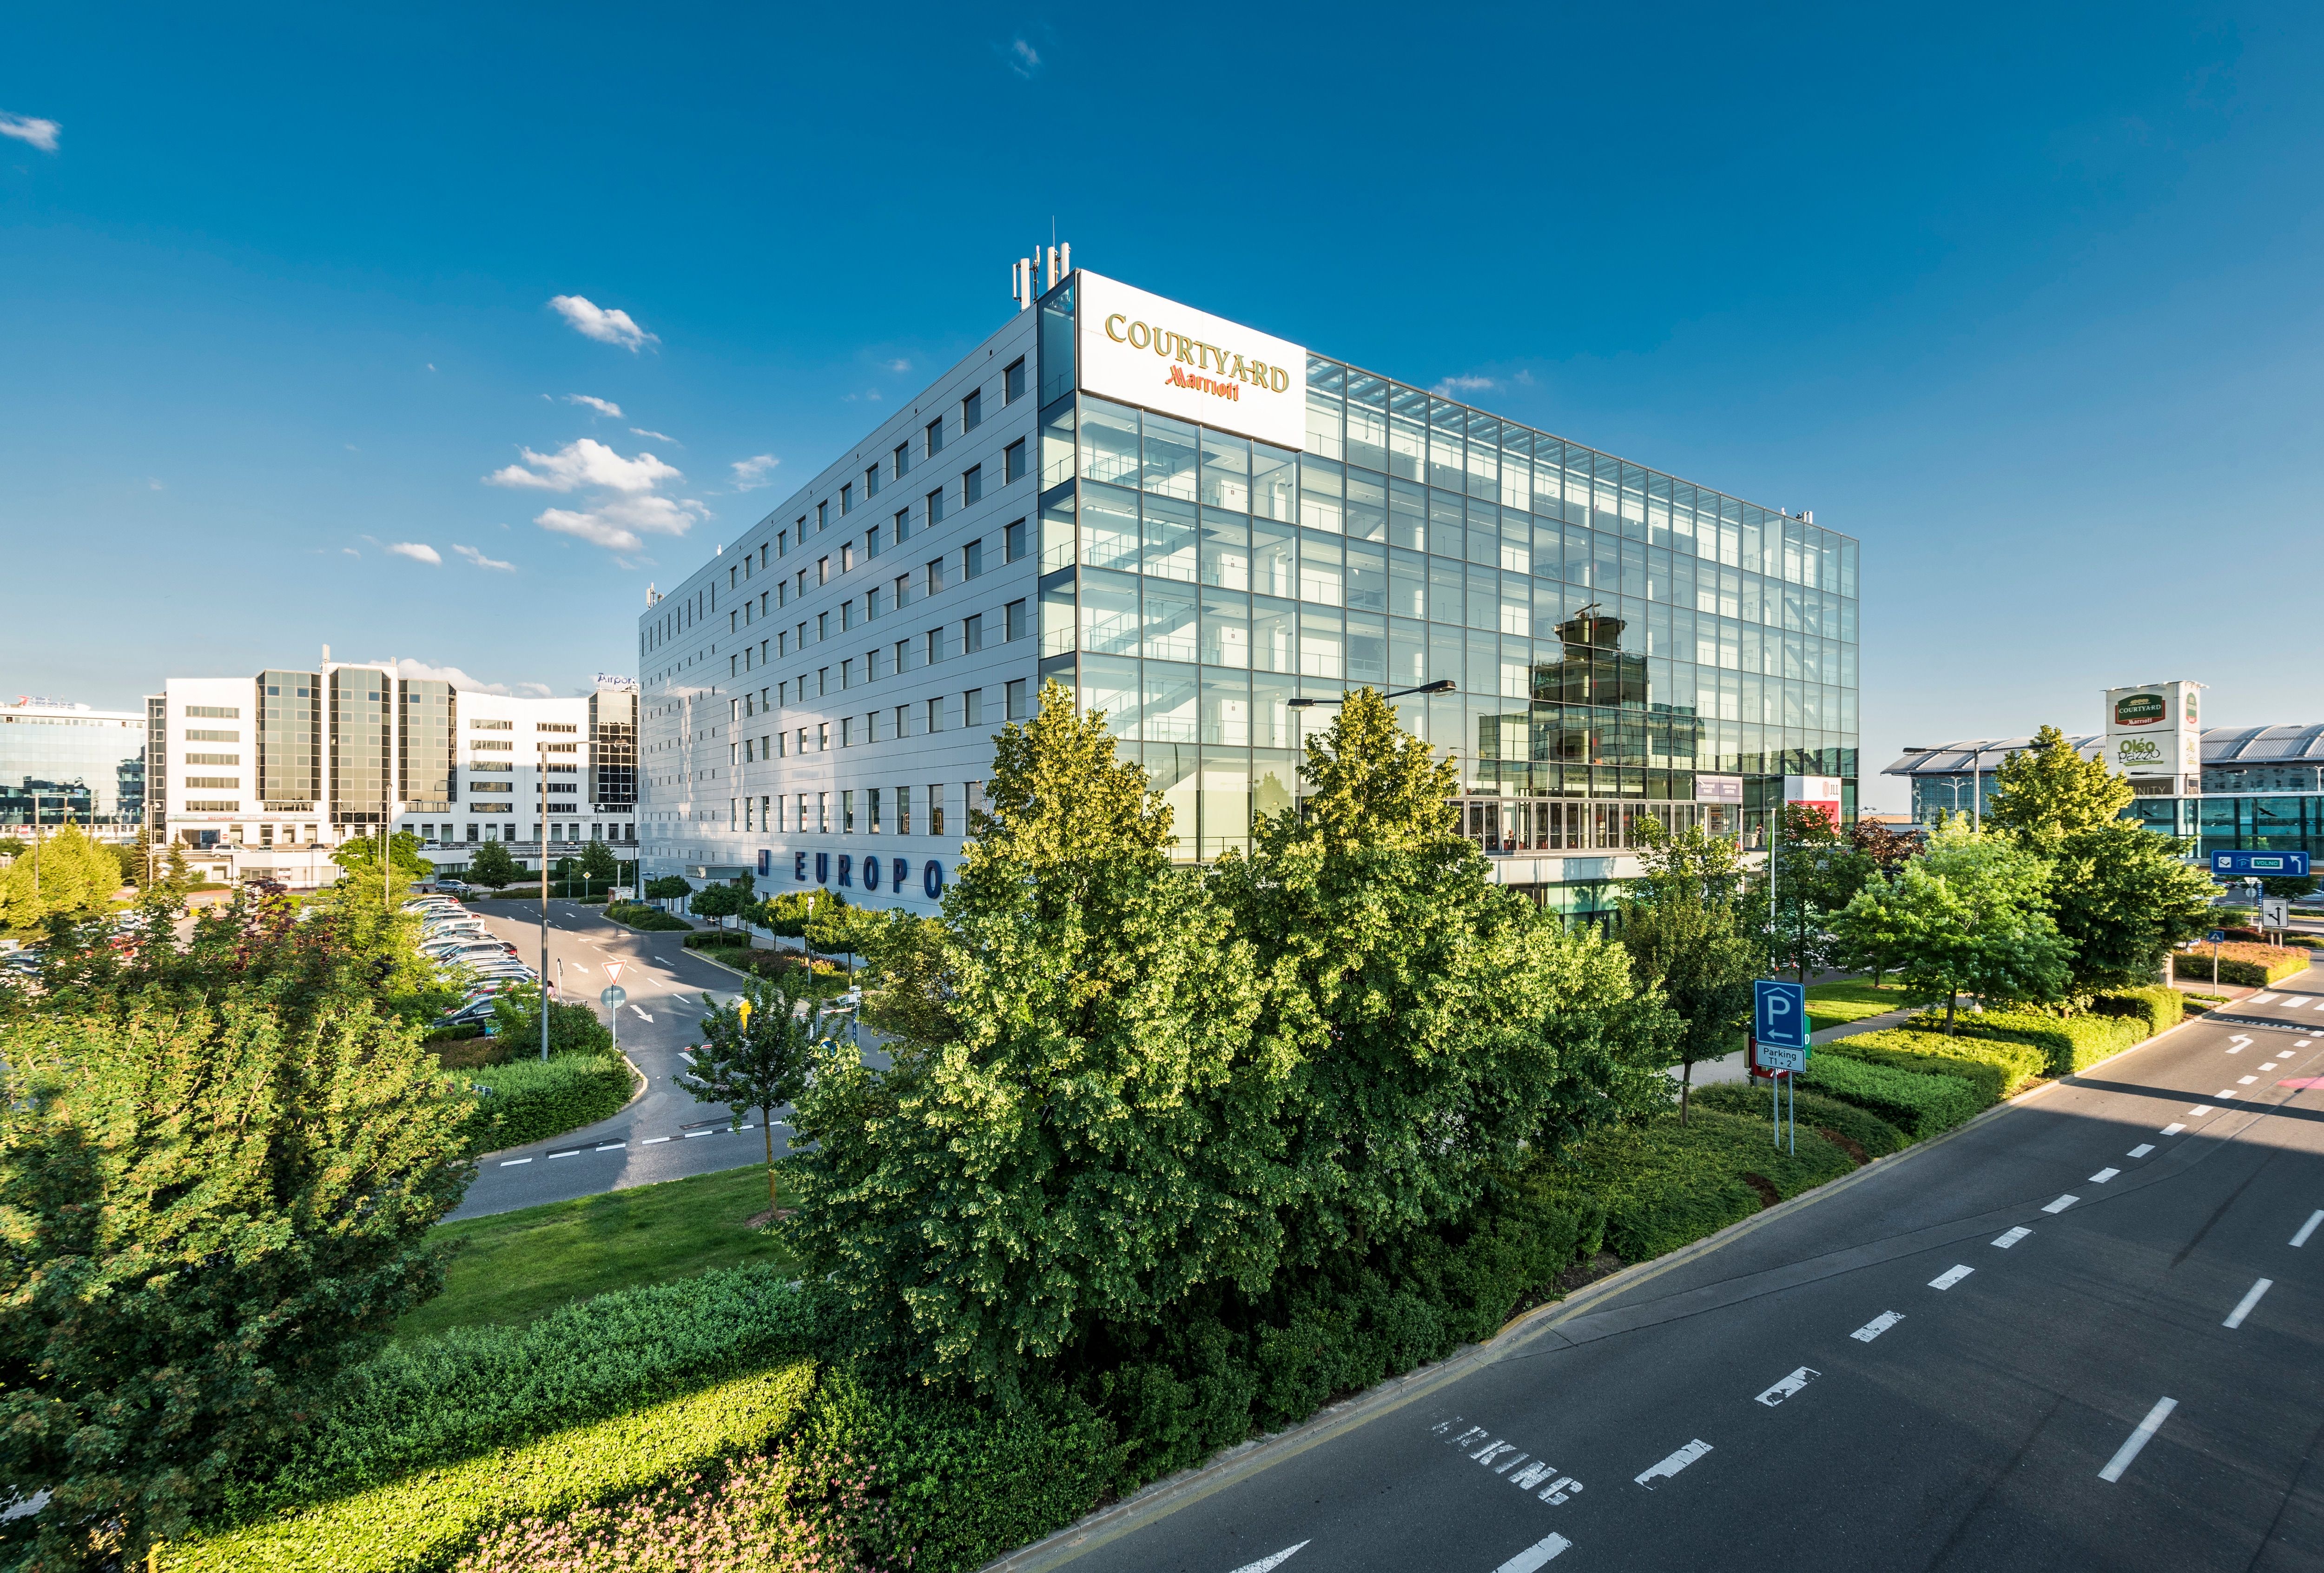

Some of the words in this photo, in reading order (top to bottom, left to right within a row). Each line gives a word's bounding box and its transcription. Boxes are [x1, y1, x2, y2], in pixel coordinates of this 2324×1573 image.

[1105, 313, 1289, 393] COURTYARD
[1165, 364, 1239, 401] Marriott
[2119, 704, 2161, 714] COURTYARD
[2120, 738, 2156, 753] Oléo
[1830, 785, 1839, 795] JLL
[2134, 786, 2166, 795] INITY
[795, 851, 970, 899] EUROPO
[1767, 995, 1790, 1025] P
[1763, 1047, 1796, 1061] Parking
[1769, 1057, 1777, 1065] T1
[1430, 1415, 1584, 1506] RKING
